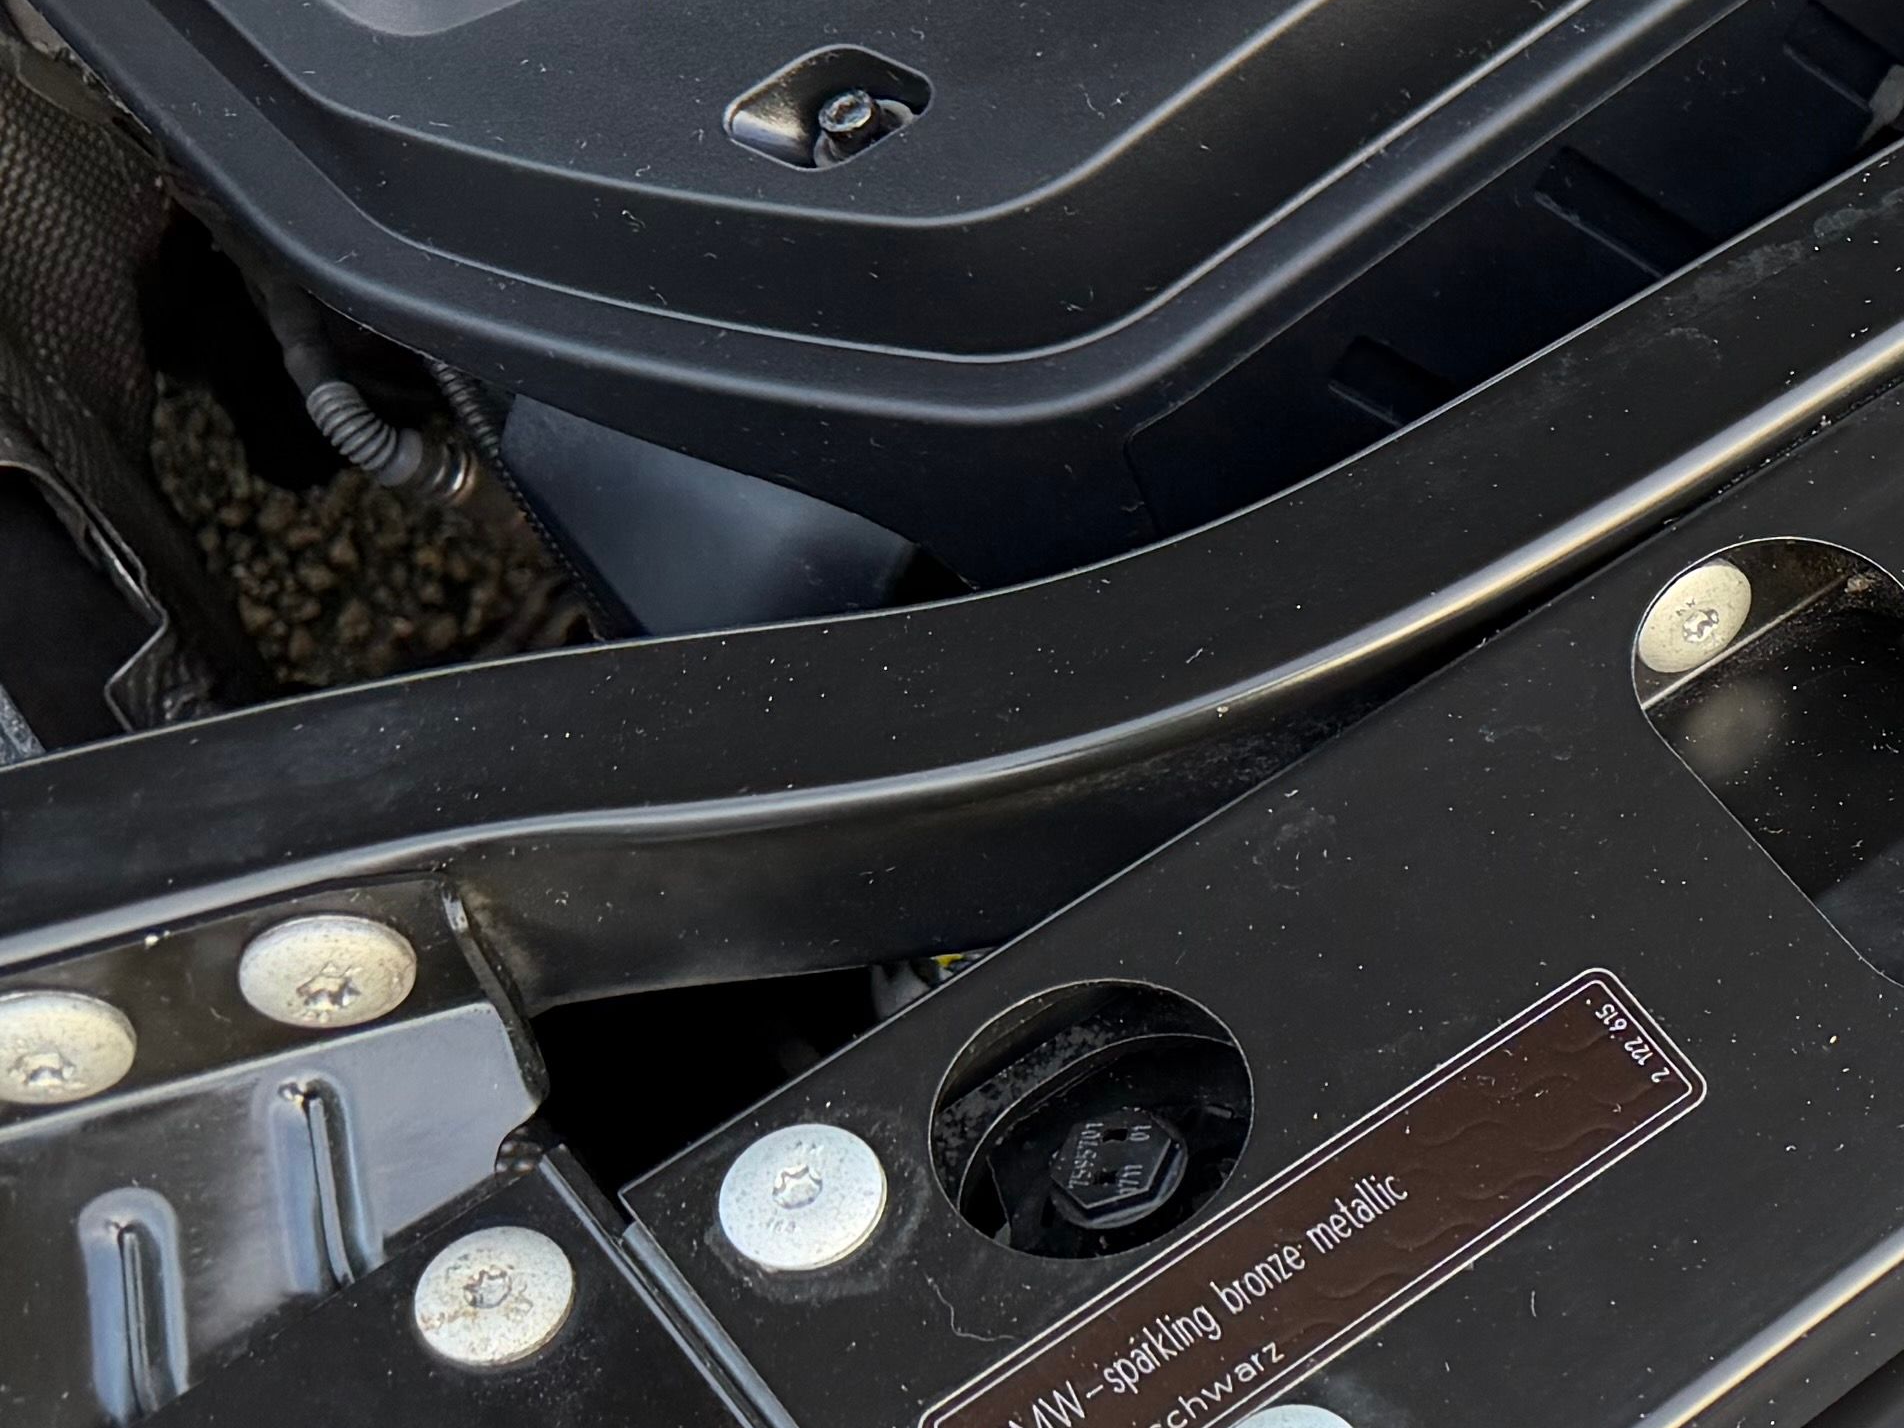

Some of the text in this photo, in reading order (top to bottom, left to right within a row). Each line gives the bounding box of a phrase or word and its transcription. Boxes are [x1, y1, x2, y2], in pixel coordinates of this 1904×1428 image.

[1595, 1004, 1670, 1083] 2 122 615
[1209, 1246, 1306, 1315] bronze
[1306, 1174, 1409, 1255] metallic
